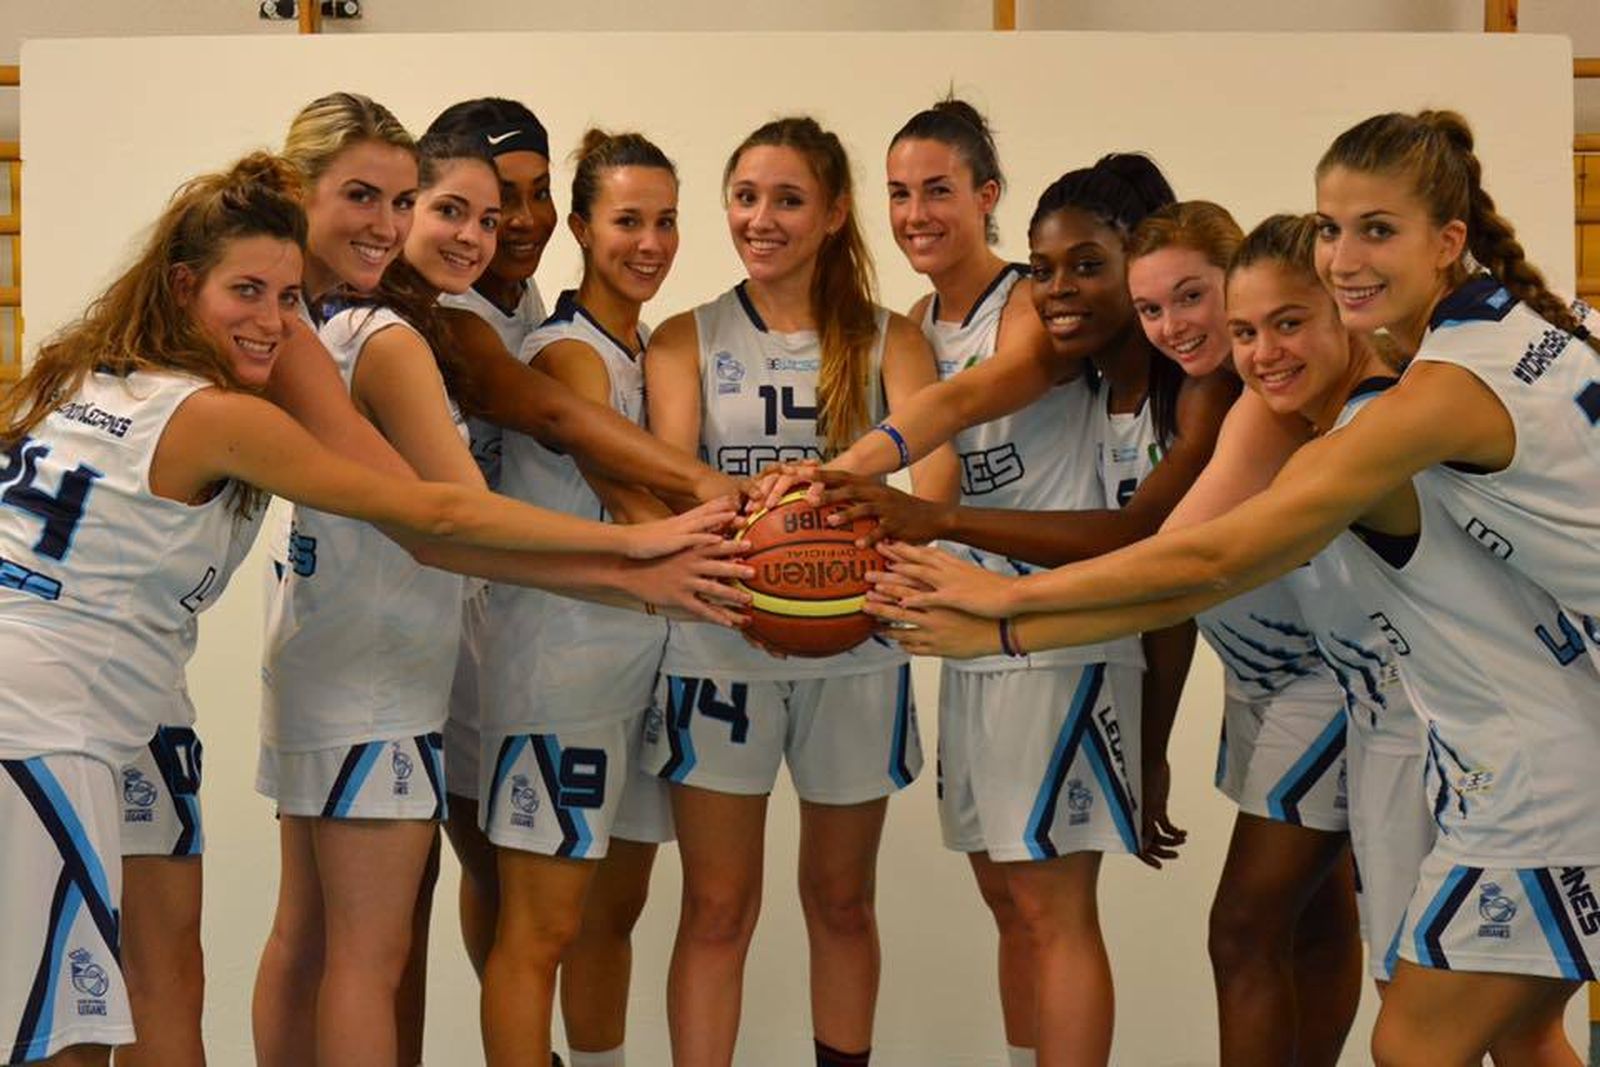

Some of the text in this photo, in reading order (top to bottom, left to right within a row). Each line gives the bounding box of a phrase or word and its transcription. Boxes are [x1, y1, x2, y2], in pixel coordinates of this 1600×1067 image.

[759, 385, 827, 437] 14
[763, 559, 878, 589] molten
[560, 747, 607, 809] 9
